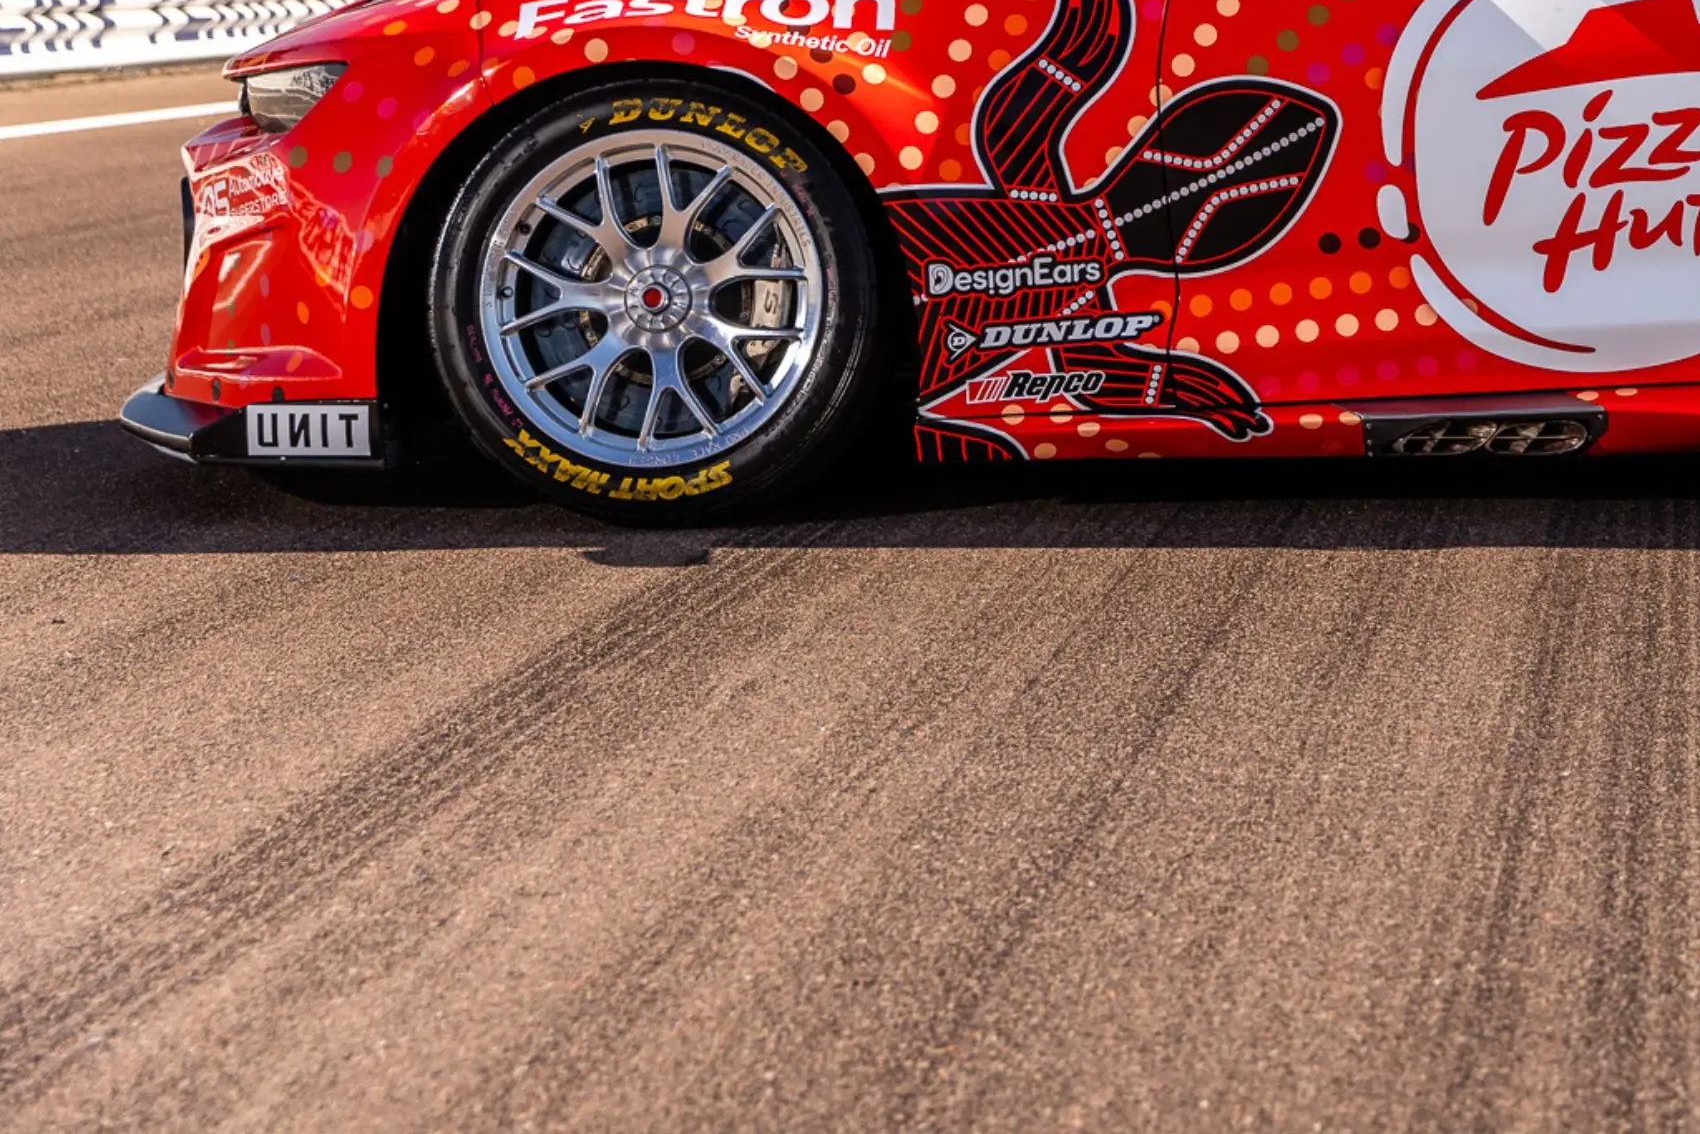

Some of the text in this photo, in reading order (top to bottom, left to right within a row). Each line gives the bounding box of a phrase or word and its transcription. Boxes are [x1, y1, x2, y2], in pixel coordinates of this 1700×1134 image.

[734, 25, 892, 58] Synthetic Oil
[608, 97, 808, 173] DUNLOP
[928, 257, 1100, 294] DesignEars
[979, 315, 1154, 348] DUNLOP
[1003, 370, 1106, 400] Repco
[502, 428, 733, 501] SPORT MAXX
